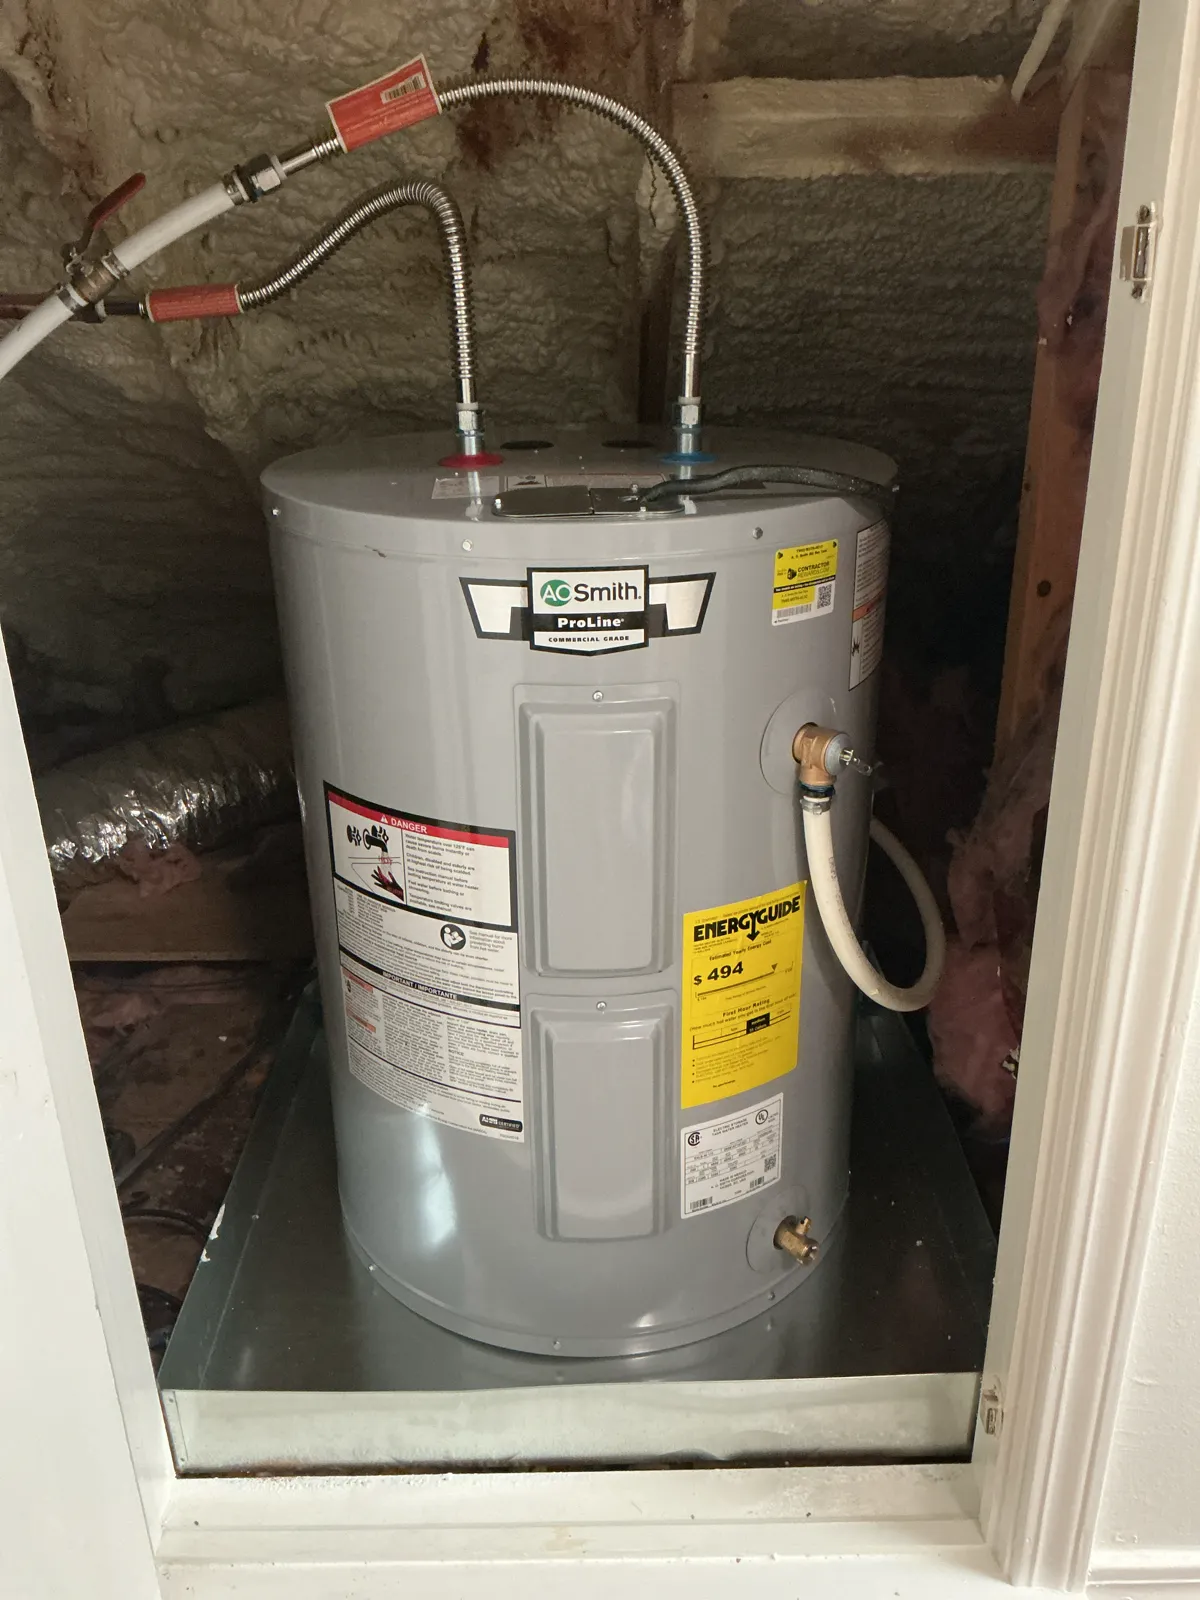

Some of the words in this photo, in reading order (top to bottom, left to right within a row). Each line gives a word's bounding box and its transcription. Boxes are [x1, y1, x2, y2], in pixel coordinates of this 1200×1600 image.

[390, 818, 428, 834] DANGER
[694, 895, 801, 942] ENERGYGUIDE
[709, 952, 732, 961] Estimated
[747, 943, 762, 951] Energy
[694, 975, 702, 986] $
[707, 961, 744, 981] 494
[382, 971, 414, 988] IMPORTANT
[417, 984, 458, 999] IMPORTANTE
[752, 999, 770, 1008] Rating
